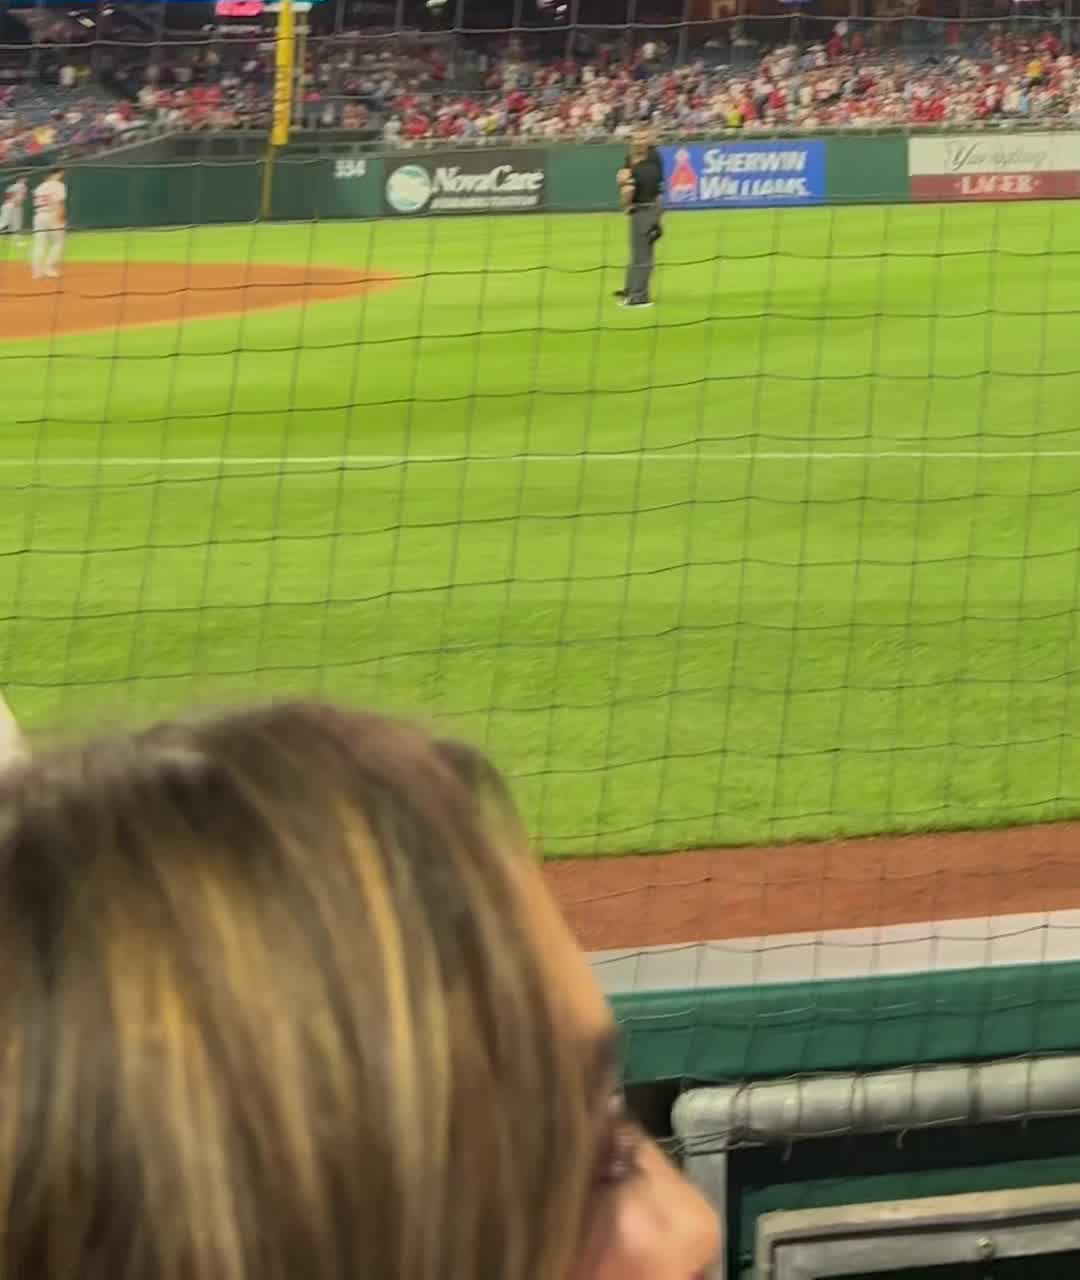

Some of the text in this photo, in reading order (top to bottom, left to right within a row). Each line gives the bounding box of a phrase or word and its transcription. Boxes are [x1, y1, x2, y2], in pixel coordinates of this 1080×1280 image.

[701, 147, 808, 174] SHERWIN
[432, 164, 545, 193] NovaCare
[962, 175, 1033, 195] LAGER
